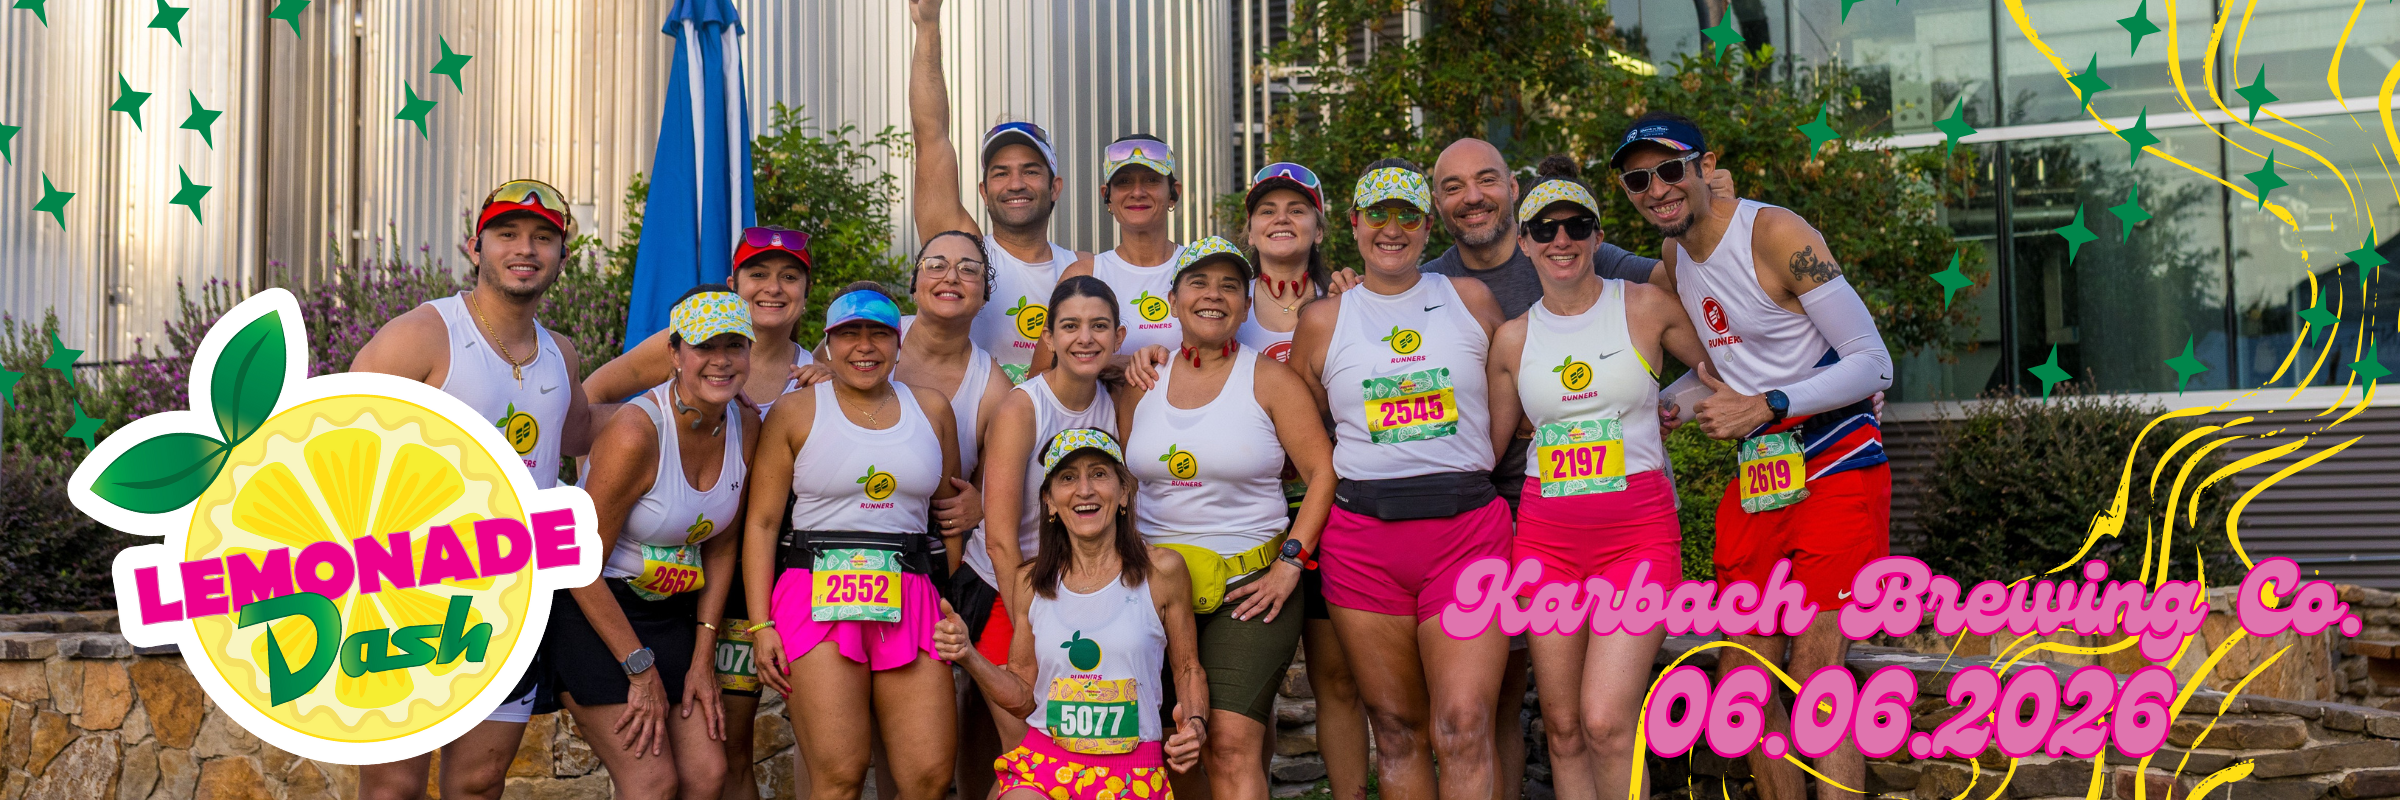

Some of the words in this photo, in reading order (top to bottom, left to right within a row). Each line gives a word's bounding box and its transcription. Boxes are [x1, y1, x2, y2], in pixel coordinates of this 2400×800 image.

[1138, 322, 1172, 330] RUNNERS
[1013, 340, 1037, 349] RUNN
[1708, 335, 1743, 348] RUNNERS
[1390, 355, 1426, 364] RUNNERS
[1380, 394, 1444, 427] 2545
[1561, 390, 1598, 402] RUNNERS
[1551, 445, 1607, 479] 2197
[1747, 459, 1791, 495] 2619
[644, 565, 698, 595] 2667
[826, 574, 889, 604] 2552
[1060, 704, 1125, 737] 5077
